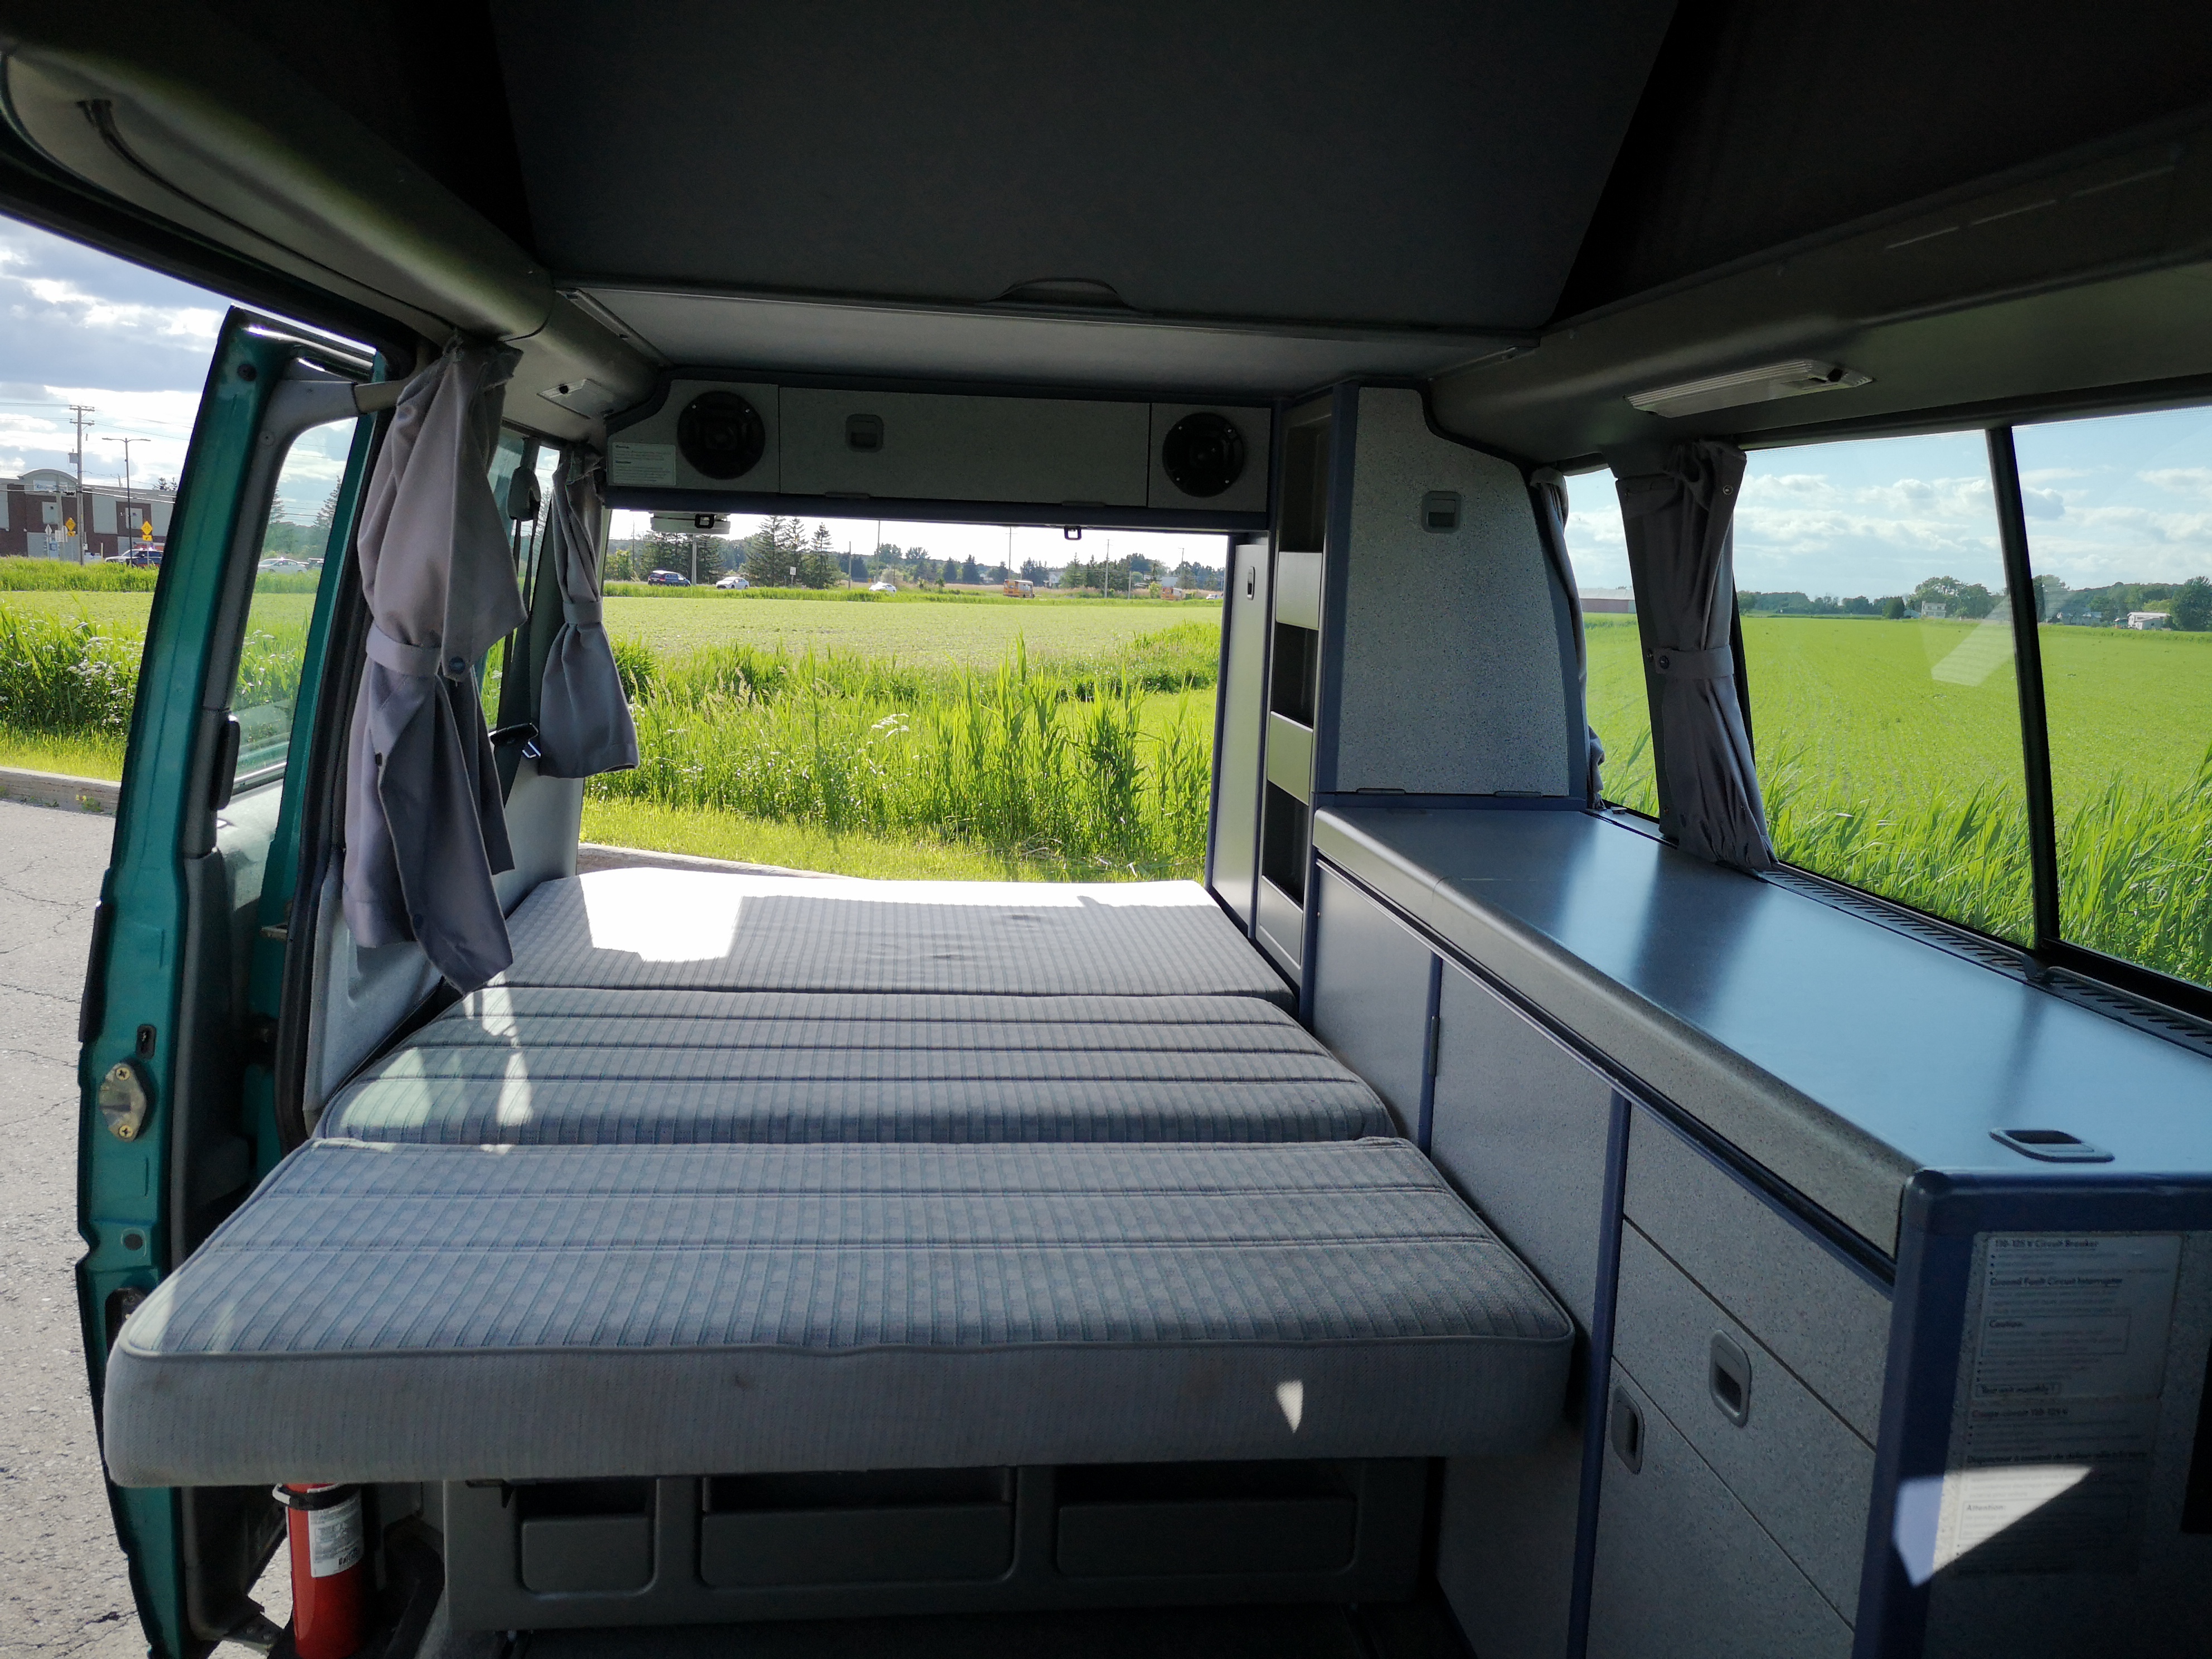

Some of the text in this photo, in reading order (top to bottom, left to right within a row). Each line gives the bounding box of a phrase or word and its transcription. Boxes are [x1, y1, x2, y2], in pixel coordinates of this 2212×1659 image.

[2035, 1239, 2063, 1248] Circuit
[2065, 1239, 2099, 1248] Breaker
[1990, 1276, 2123, 1287] Ground Fault Circuit Interrupter
[1966, 1503, 2006, 1512] Attention:
